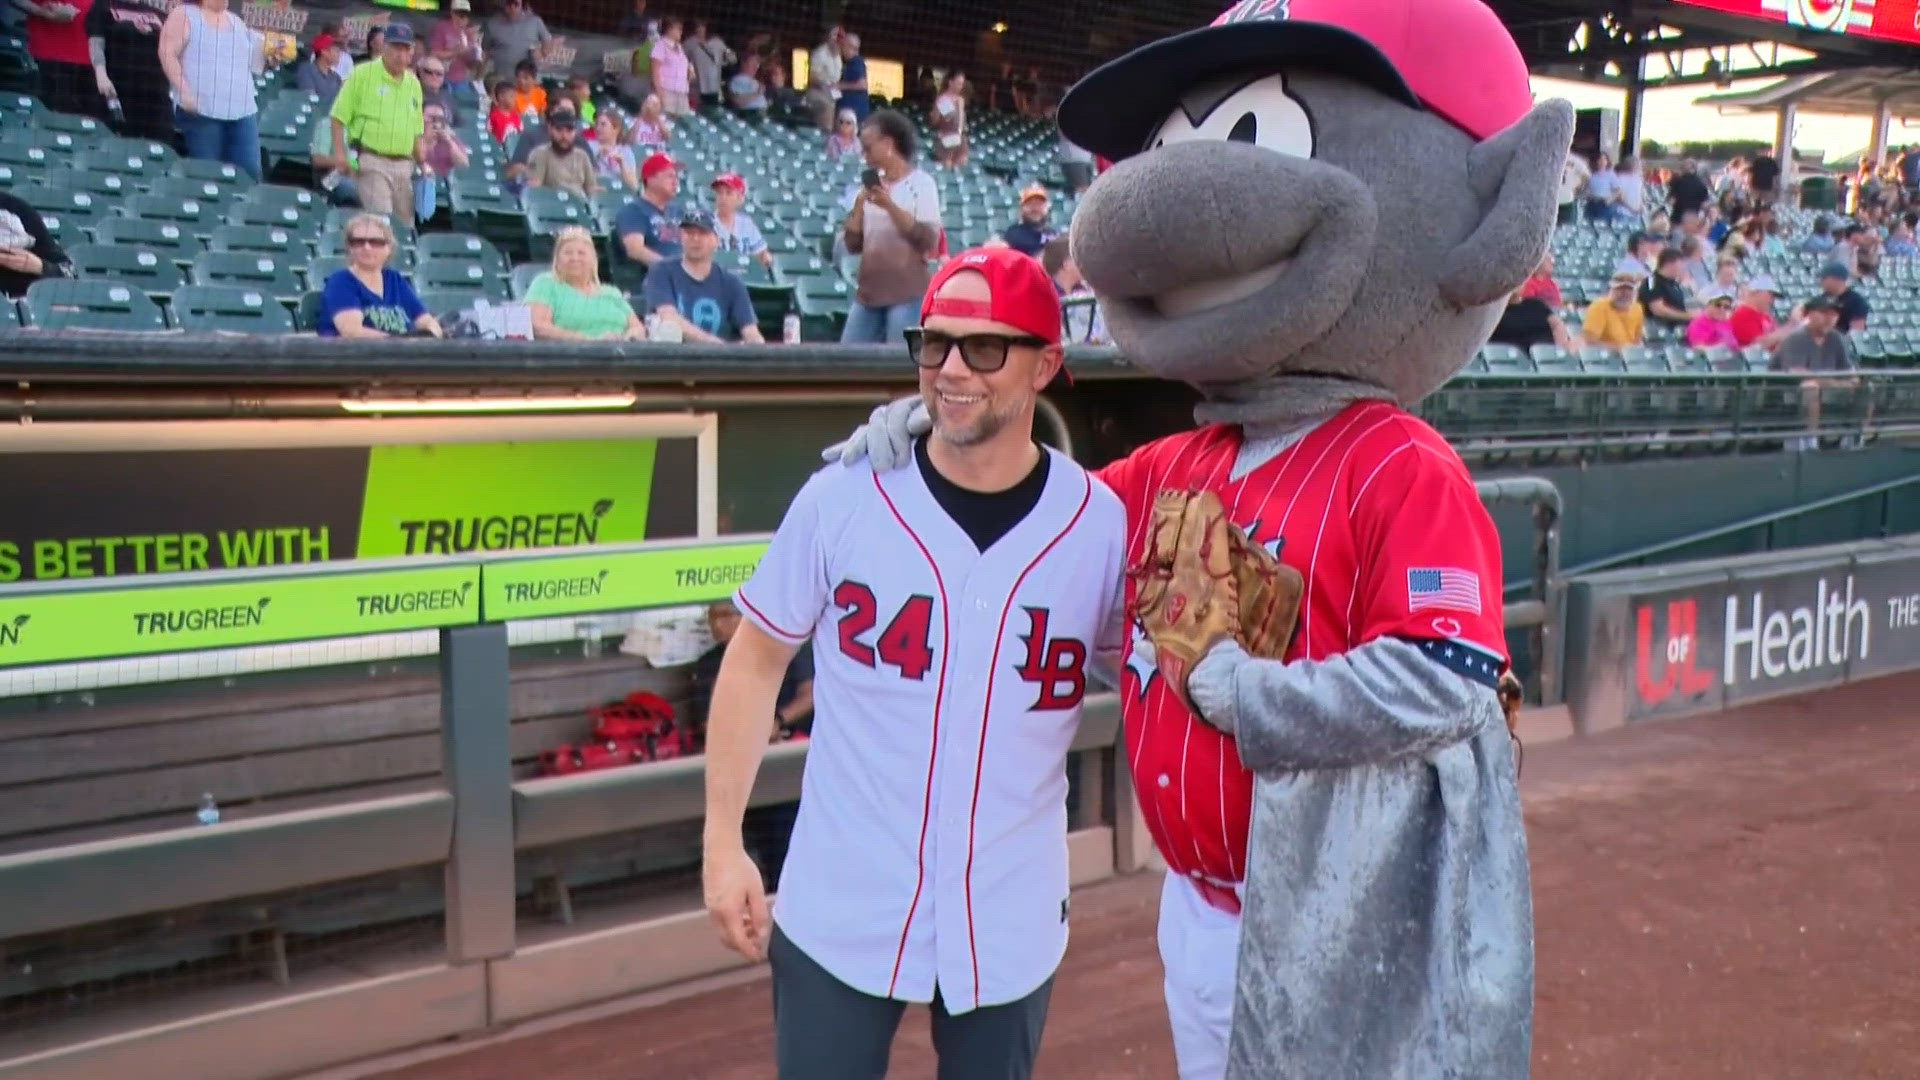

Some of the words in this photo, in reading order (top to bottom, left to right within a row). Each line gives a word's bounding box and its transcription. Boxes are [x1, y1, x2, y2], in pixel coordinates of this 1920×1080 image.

[33, 533, 209, 580] BETTER
[218, 526, 330, 569] WITH
[400, 511, 600, 555] TRUGREEN
[356, 588, 466, 616] TRUGREEN
[505, 576, 602, 603] TRUGREEN
[133, 605, 262, 635] TRUGREEN
[834, 579, 934, 681] 24
[1724, 575, 1869, 685] Health
[1888, 594, 1920, 629] THE
[1012, 605, 1087, 711] LB
